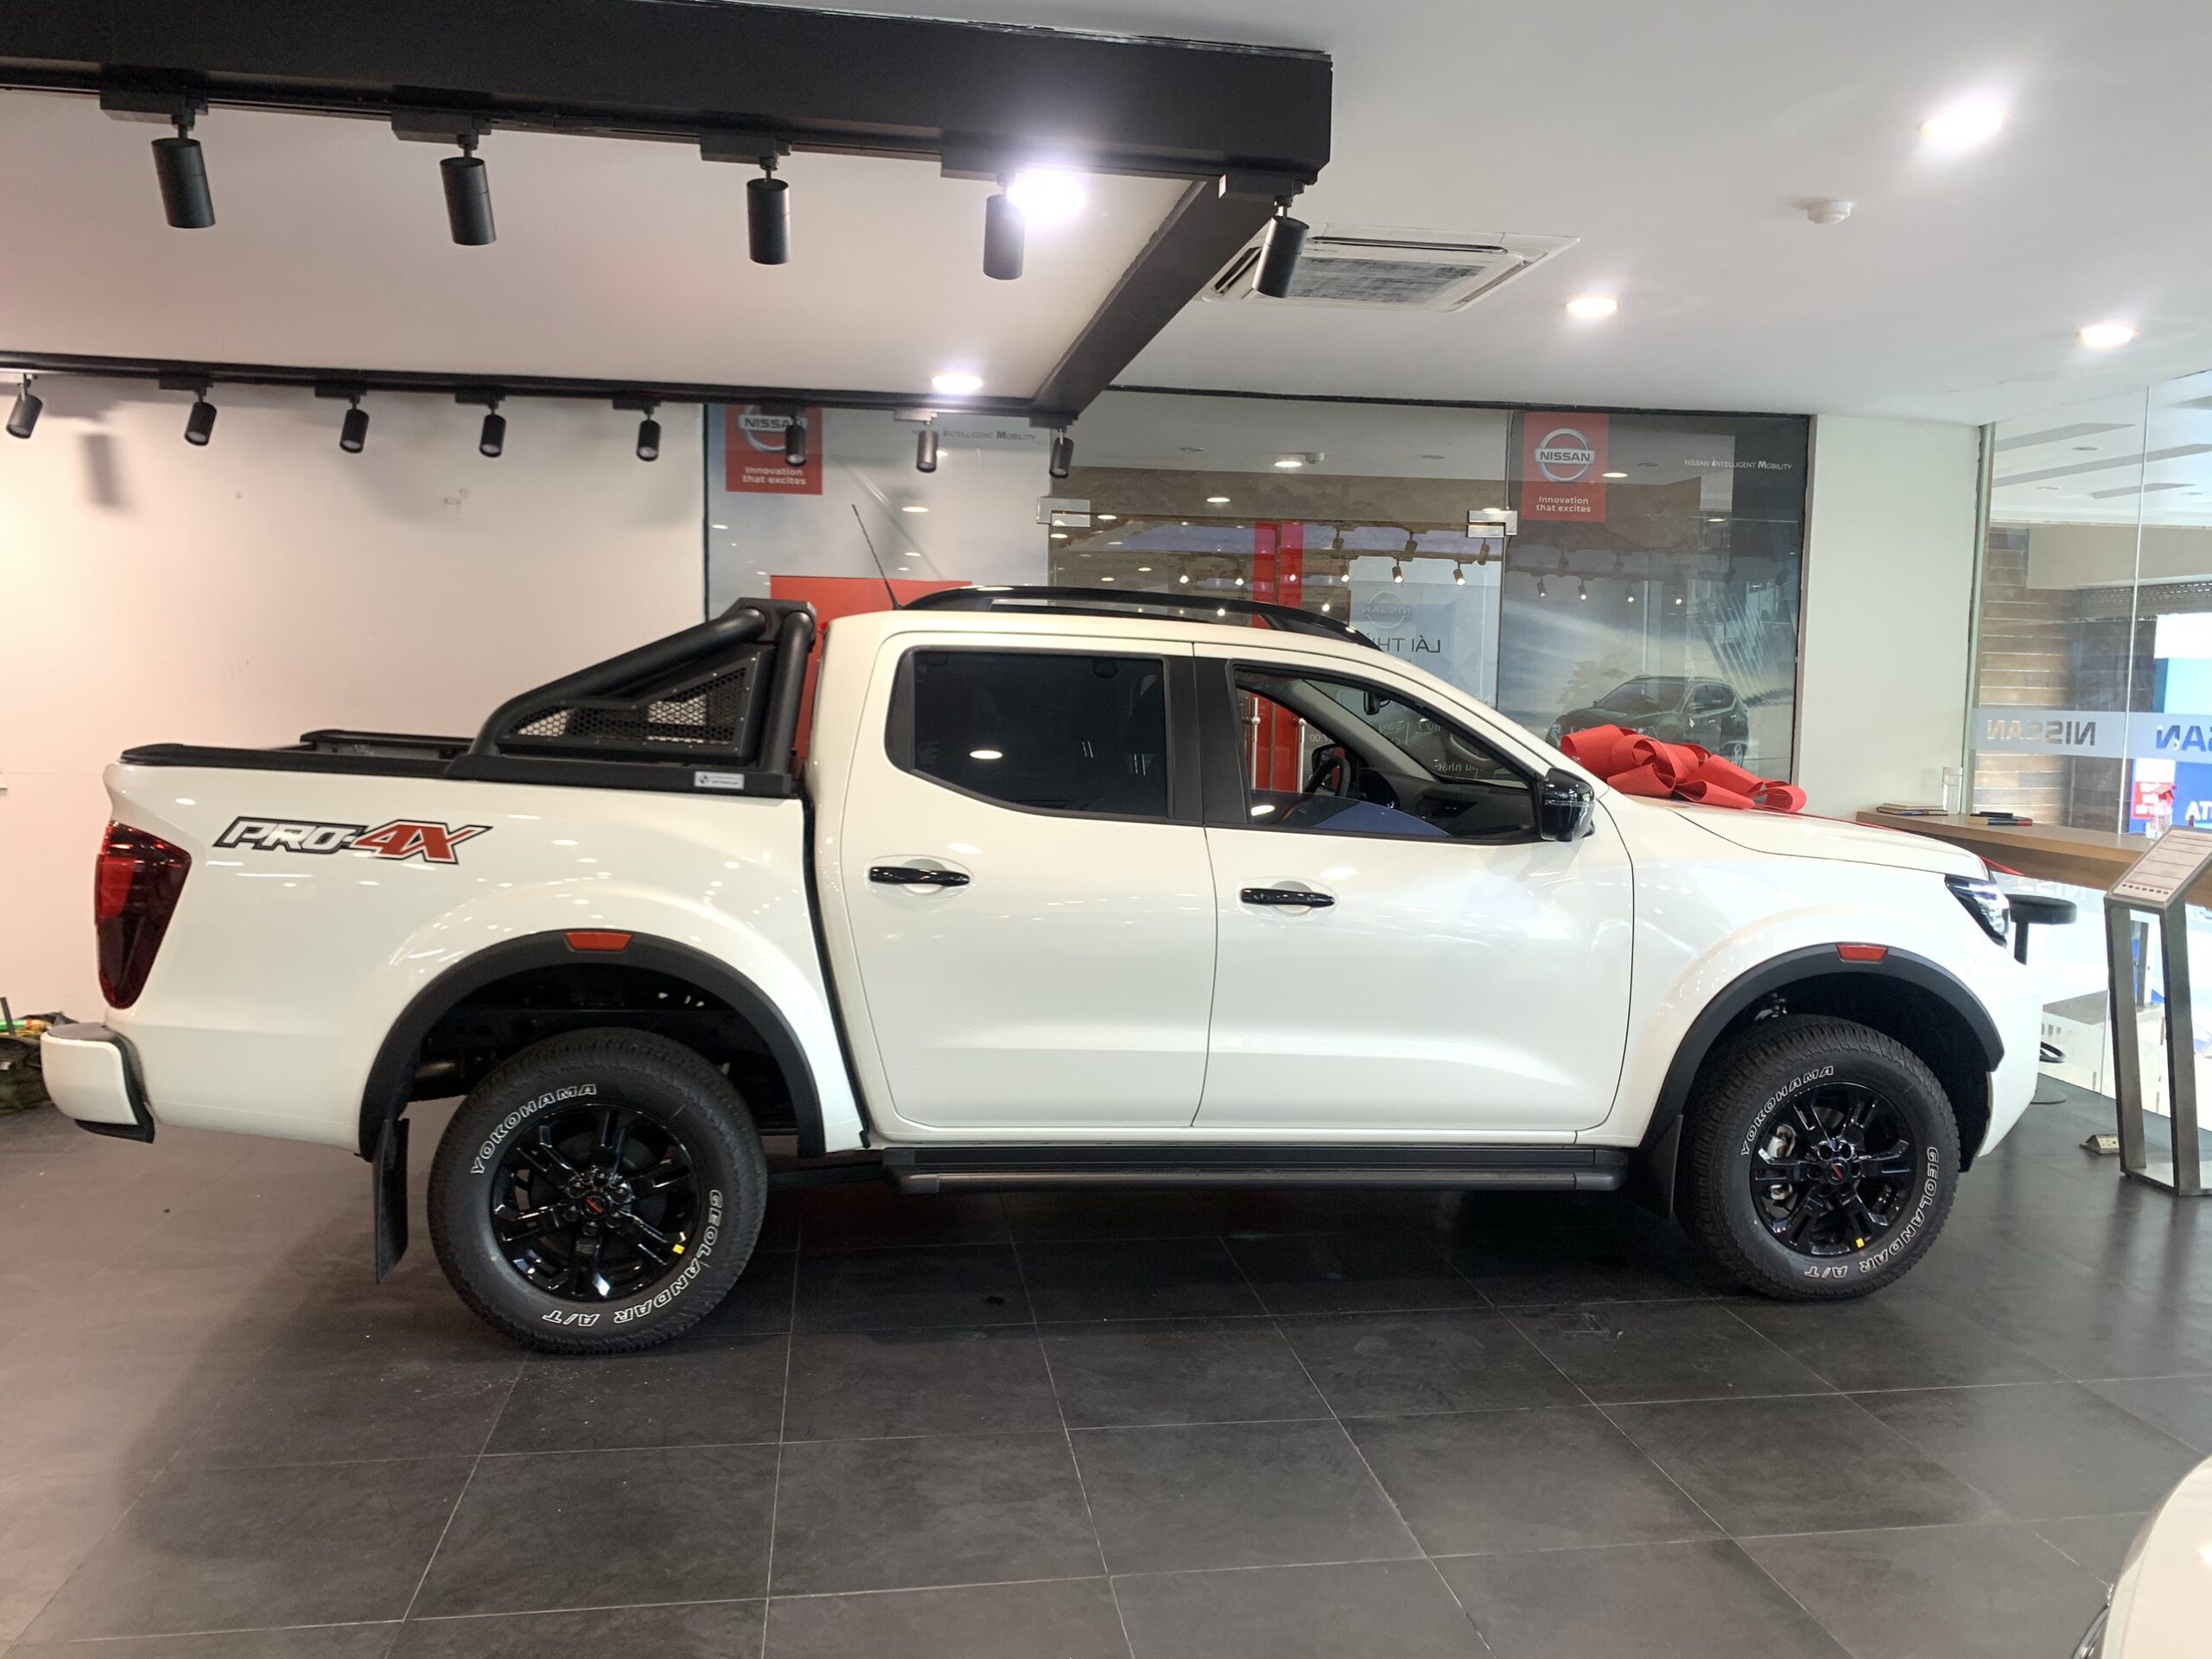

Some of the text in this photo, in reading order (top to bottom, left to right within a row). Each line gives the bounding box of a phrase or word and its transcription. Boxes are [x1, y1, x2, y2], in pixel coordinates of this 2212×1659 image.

[745, 418, 791, 429] NISSA
[1540, 451, 1590, 461] NISSAN
[742, 474, 807, 485] that excites
[745, 467, 804, 476] Innovation
[1538, 496, 1589, 505] Innovation
[2184, 800, 2212, 821] AT
[1740, 1066, 1834, 1156] YOKOHAMA
[471, 1084, 596, 1175] YOKOHAMA
[1804, 1147, 1939, 1278] GEOLANDAR A/T
[542, 1189, 723, 1327] GEOLANDAR A/T
